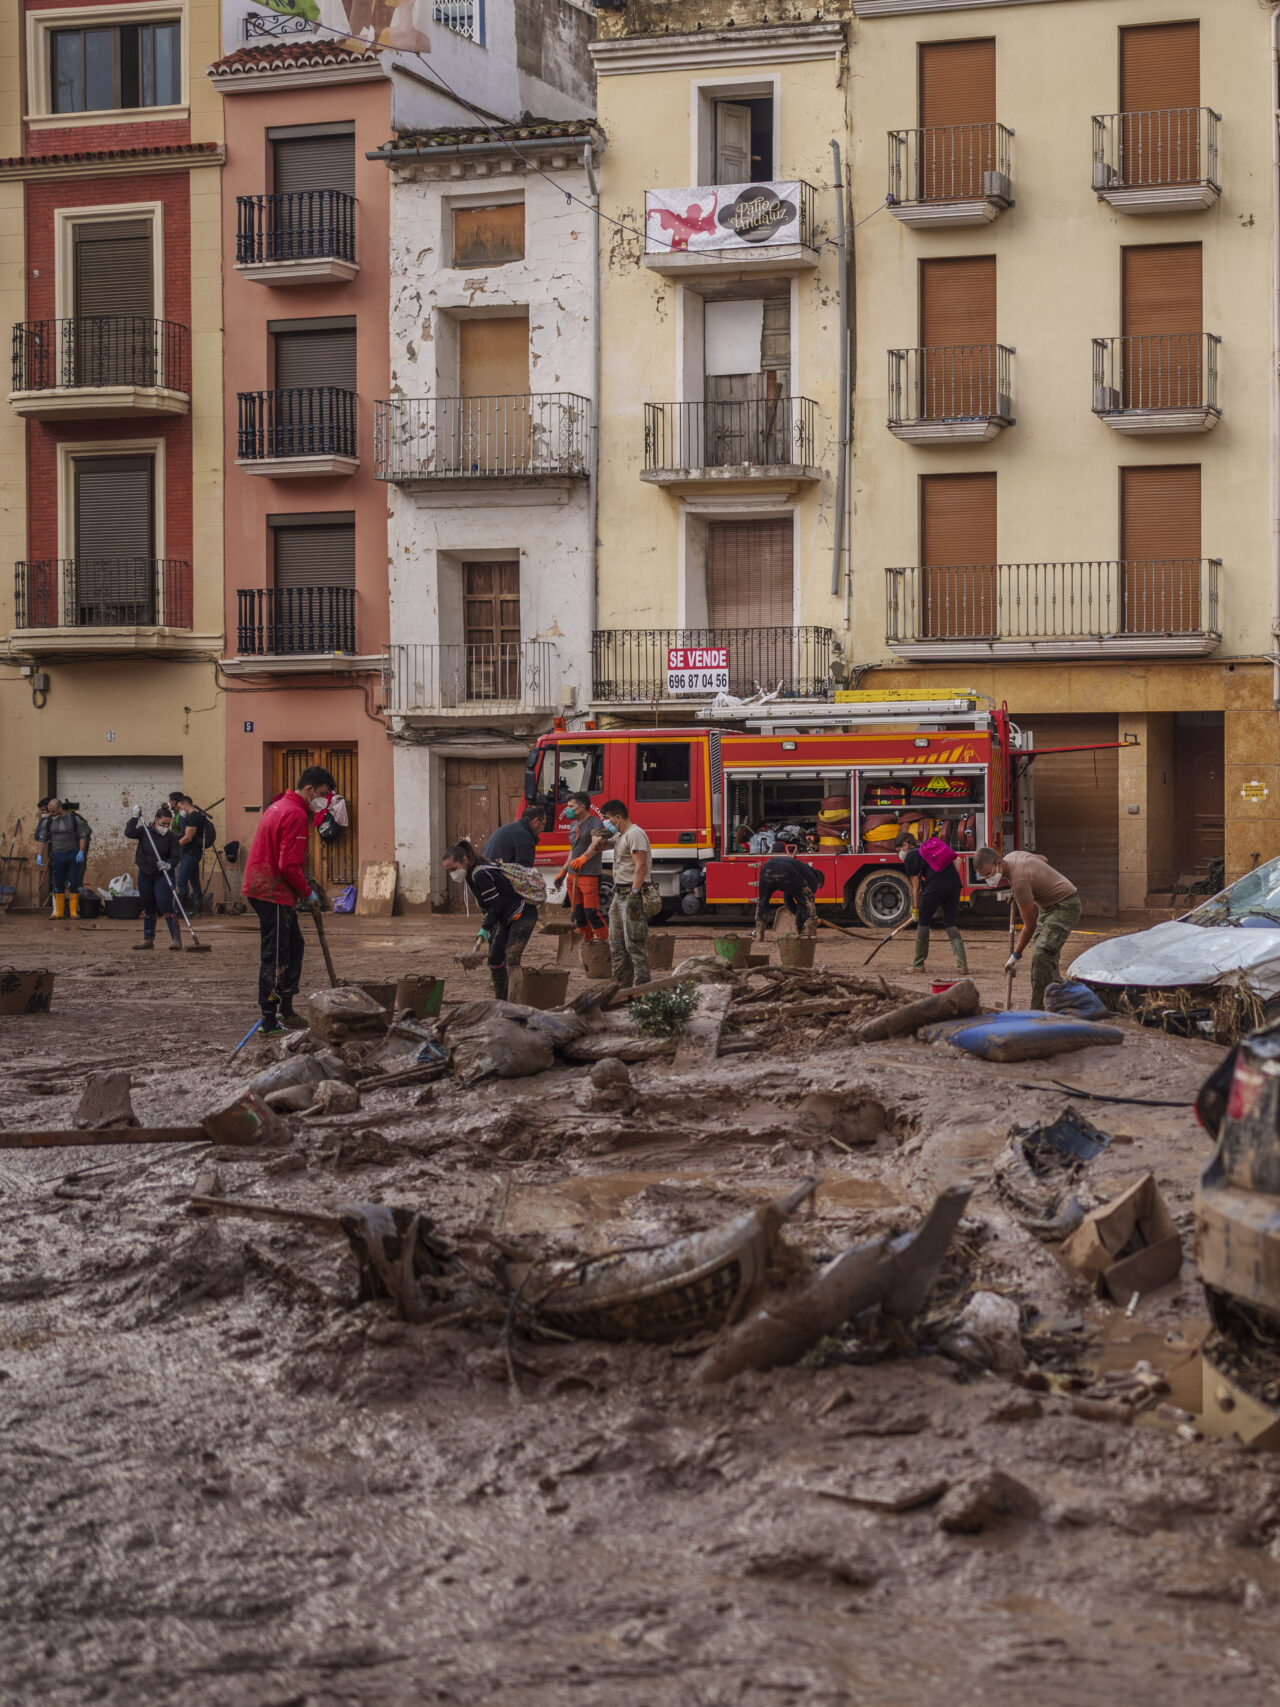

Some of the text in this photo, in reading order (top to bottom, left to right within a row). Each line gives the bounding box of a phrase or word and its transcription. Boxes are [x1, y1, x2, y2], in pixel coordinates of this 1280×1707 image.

[736, 196, 770, 215] Patio
[669, 650, 727, 668] SE VENDE
[669, 673, 727, 688] 696 87 04 56
